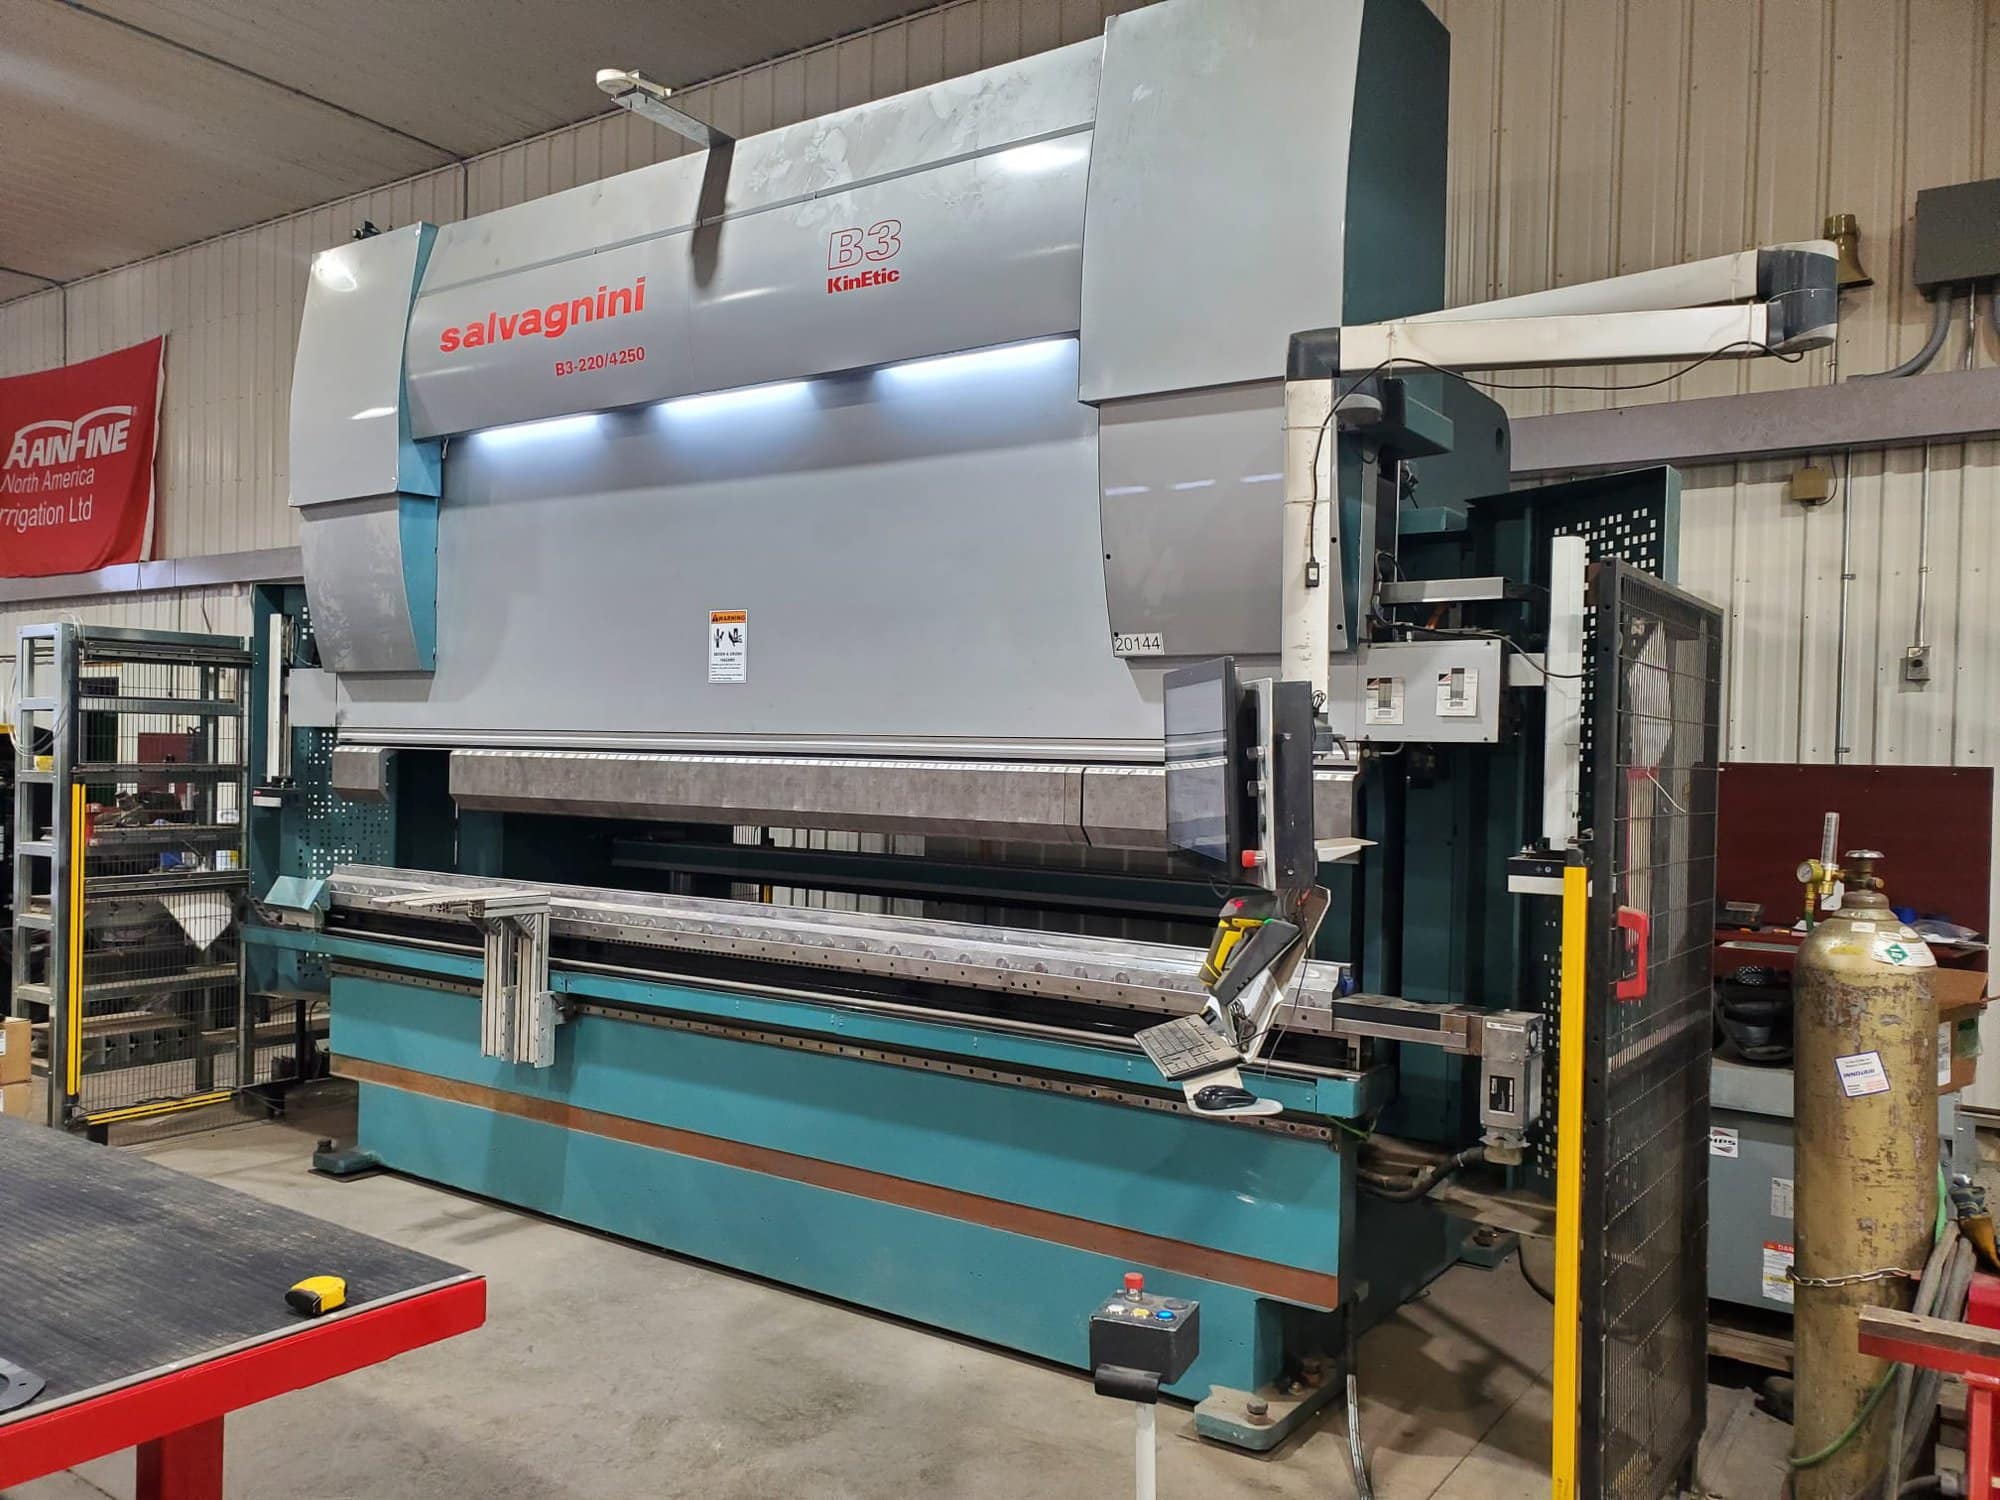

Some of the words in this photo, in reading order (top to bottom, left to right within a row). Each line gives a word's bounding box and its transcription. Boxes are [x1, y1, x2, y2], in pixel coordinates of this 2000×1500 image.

[827, 219, 902, 271] B3
[827, 267, 900, 294] KinEtic
[440, 276, 646, 353] salvagnini
[555, 346, 646, 377] B3-220/4250
[2, 405, 132, 470] RAINFINE
[0, 471, 39, 494] North
[42, 465, 95, 491] America
[0, 500, 64, 533] rrigation
[69, 493, 93, 523] Ltd
[1115, 636, 1160, 651] 20144
